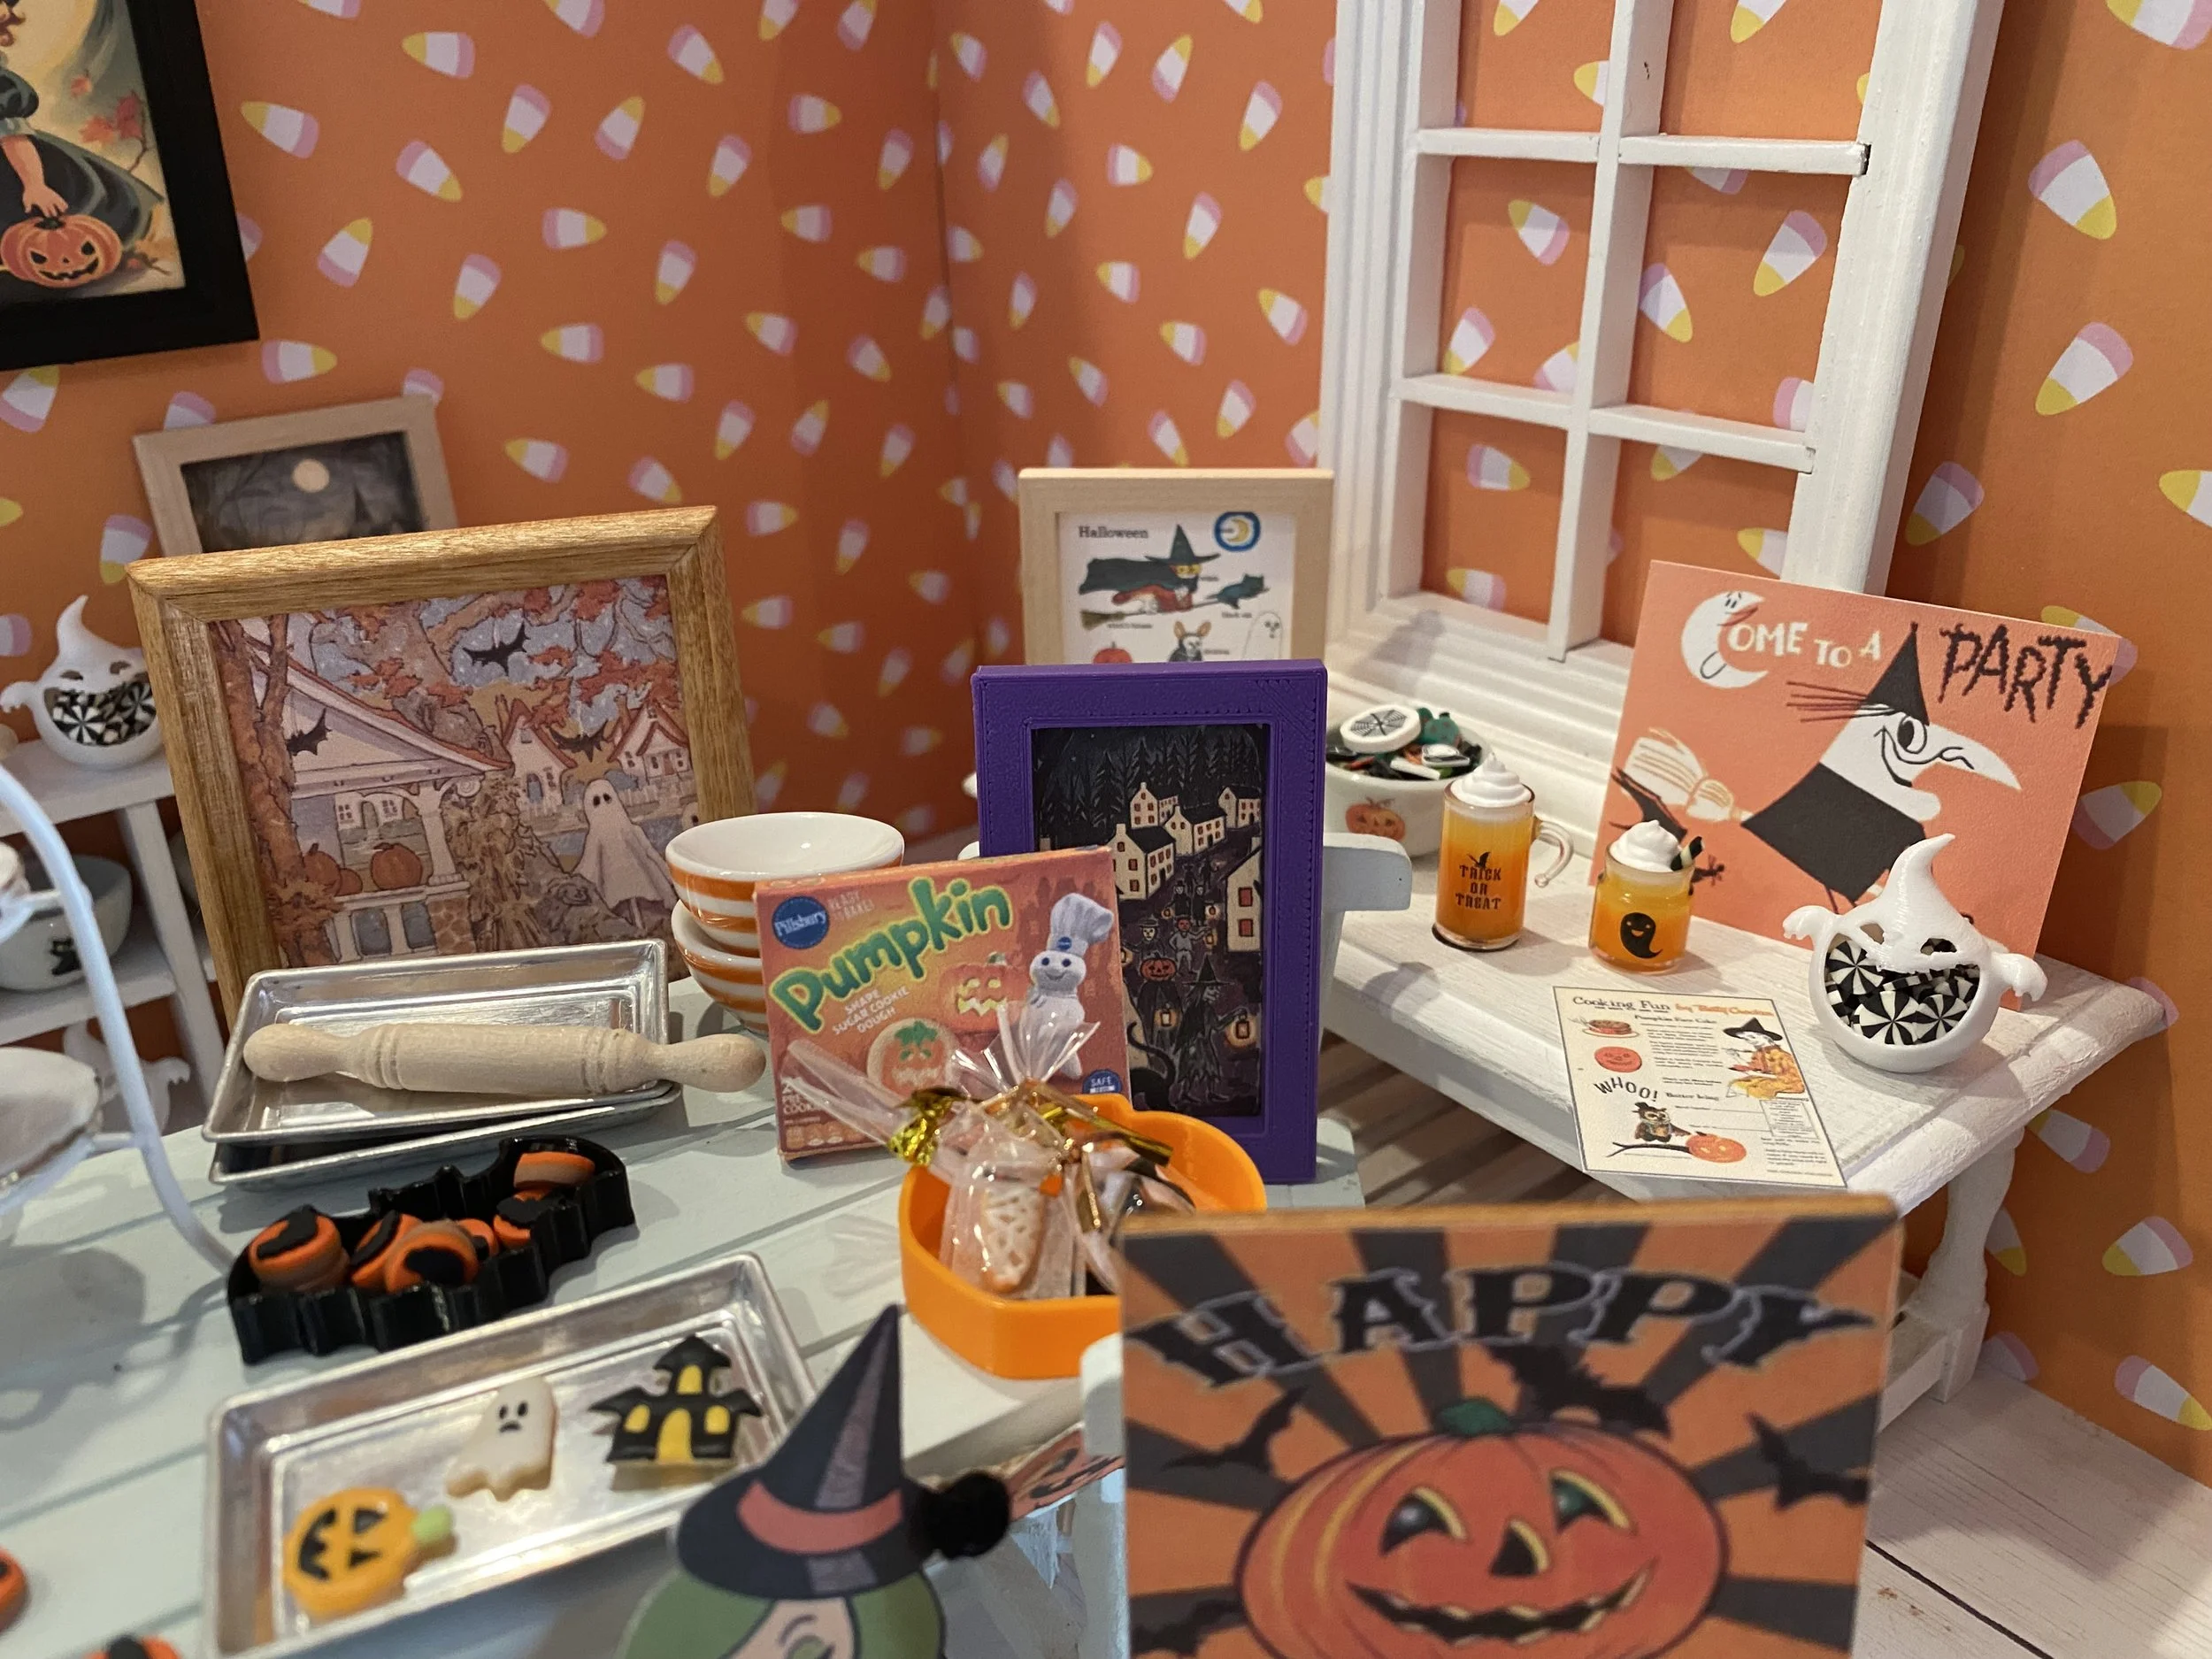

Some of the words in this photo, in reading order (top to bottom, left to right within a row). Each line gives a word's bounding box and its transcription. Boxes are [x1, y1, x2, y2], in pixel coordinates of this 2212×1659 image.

[1078, 526, 1148, 539] Halloween
[1813, 638, 1851, 669] TO
[1859, 630, 1882, 662] A
[1938, 623, 2113, 730] PARTY
[1459, 864, 1502, 880] TRICK
[1470, 882, 1488, 895] OR
[1455, 893, 1502, 910] TREAT
[774, 910, 826, 937] Pillsbury
[770, 877, 1013, 1033] Pumpkin
[1572, 996, 1633, 1010] Cooking
[1640, 1000, 1671, 1010] Fun
[1091, 1076, 1112, 1087] SAFE
[1593, 1076, 1658, 1102] WHOO!
[1125, 1261, 1876, 1390] HAPPY
